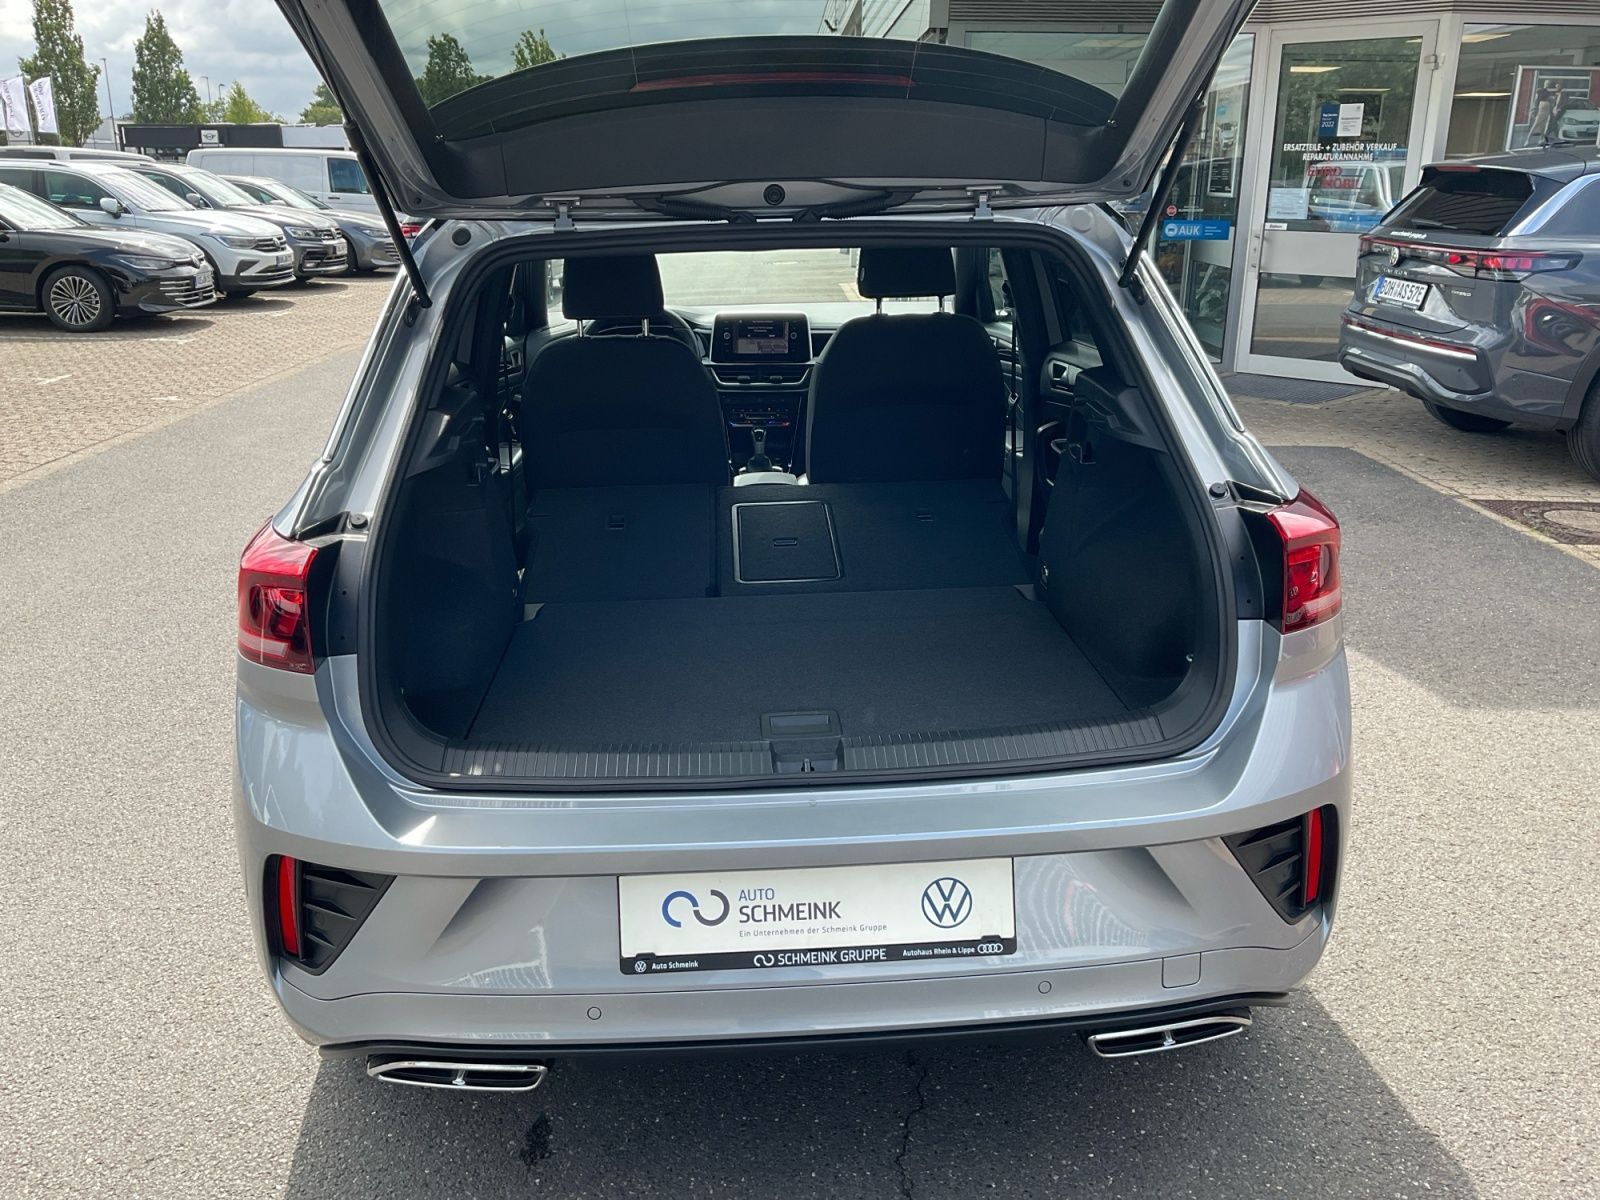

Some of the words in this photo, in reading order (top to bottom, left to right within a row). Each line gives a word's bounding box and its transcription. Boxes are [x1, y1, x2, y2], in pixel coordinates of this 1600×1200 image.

[1332, 142, 1365, 152] ZUBEHÖR
[1366, 143, 1398, 152] VERKAUF
[1302, 152, 1374, 161] REPARATURANNAHME
[1178, 225, 1200, 235] AUK
[739, 888, 775, 901] AUTO
[739, 901, 842, 924] SCHMEINK
[753, 926, 805, 937] Unternehmen
[807, 926, 819, 934] der
[822, 924, 857, 934] Schmeink
[859, 923, 888, 933] Gruppe
[777, 951, 836, 966] SCHMEINK
[840, 948, 887, 962] GRUPPE
[902, 948, 933, 957] Autohaus
[933, 946, 951, 955] Rhein
[958, 945, 976, 956] Lippe
[651, 961, 667, 970] Auto
[668, 960, 699, 970] Schmeink
